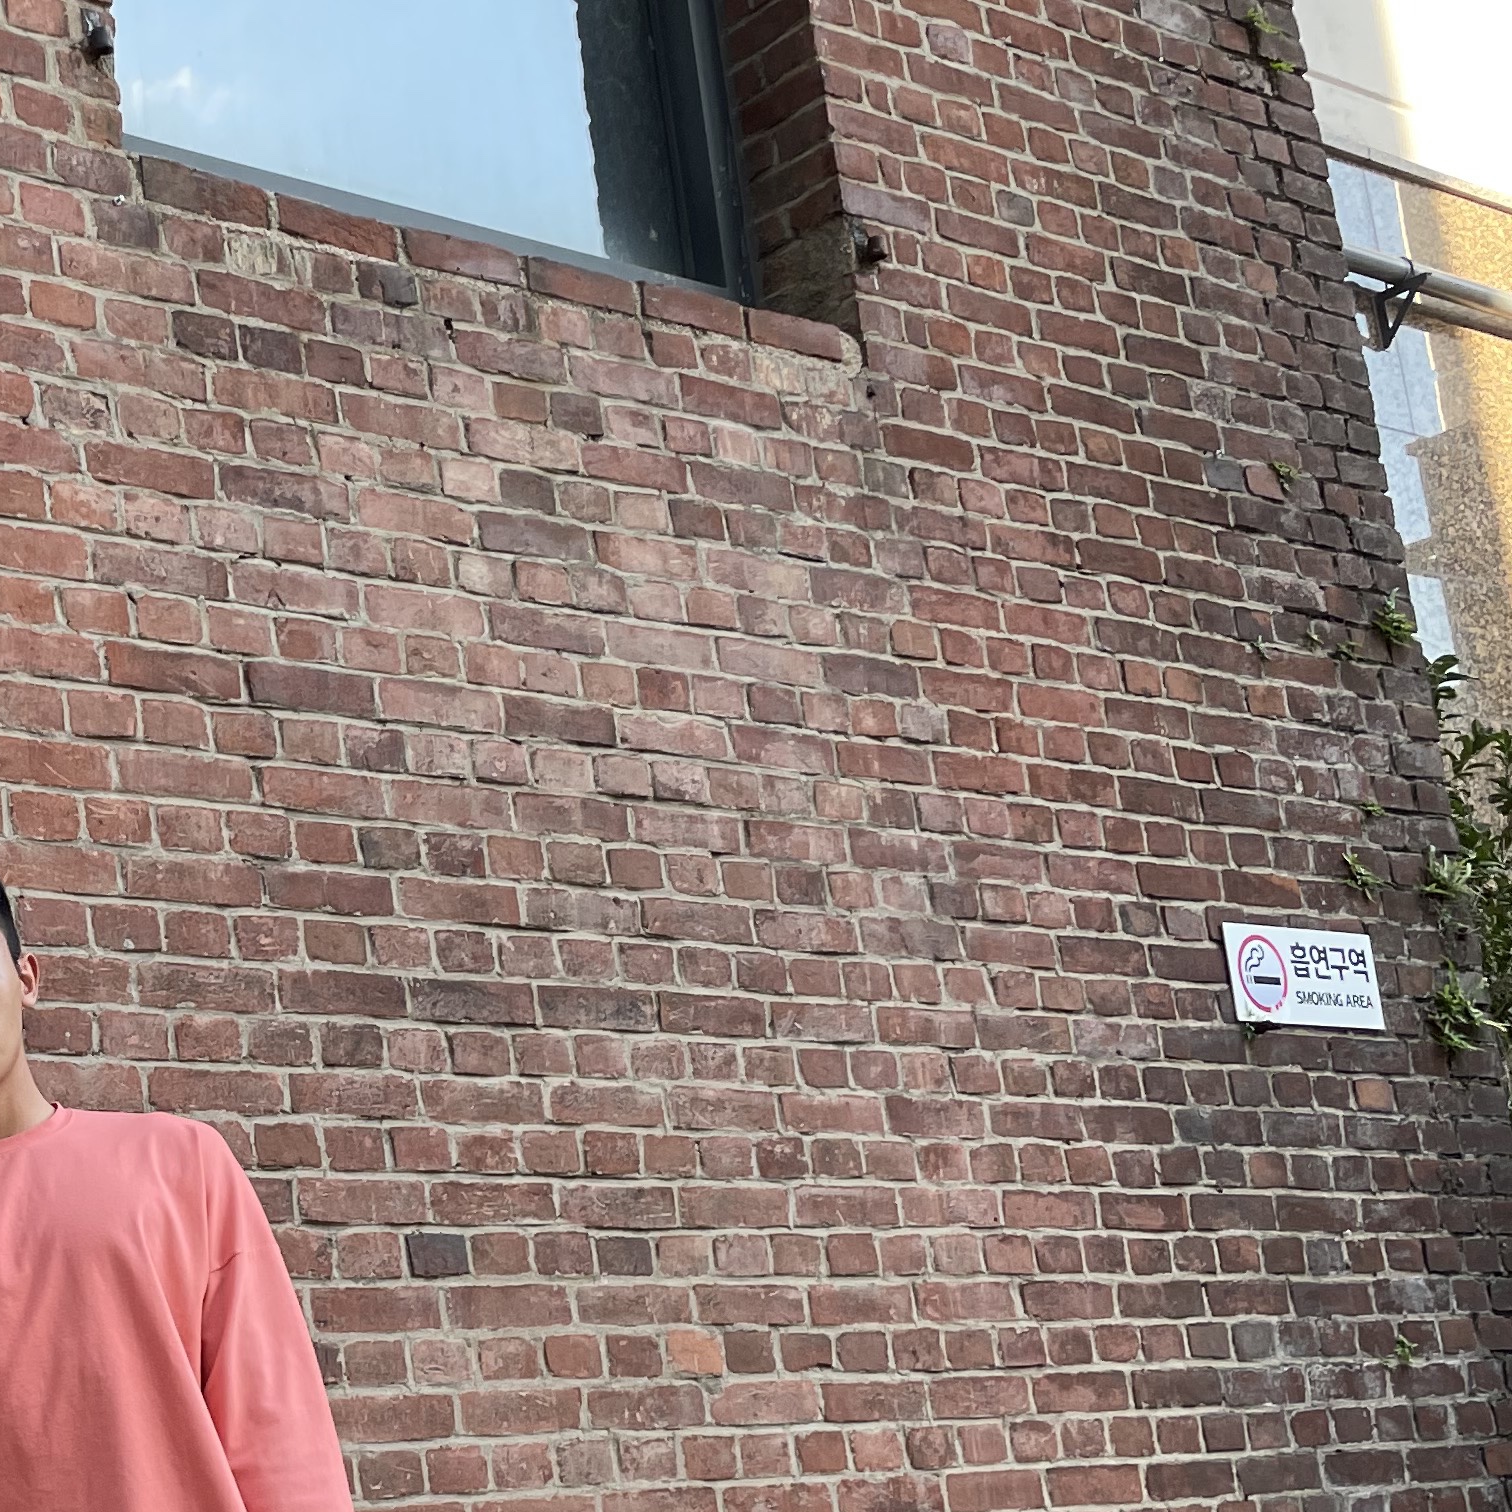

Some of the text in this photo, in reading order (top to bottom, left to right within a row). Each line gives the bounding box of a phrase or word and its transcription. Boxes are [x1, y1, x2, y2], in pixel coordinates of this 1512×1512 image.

[1289, 941, 1370, 983] 흡연구역
[1295, 990, 1374, 1009] SMOKING AREA
